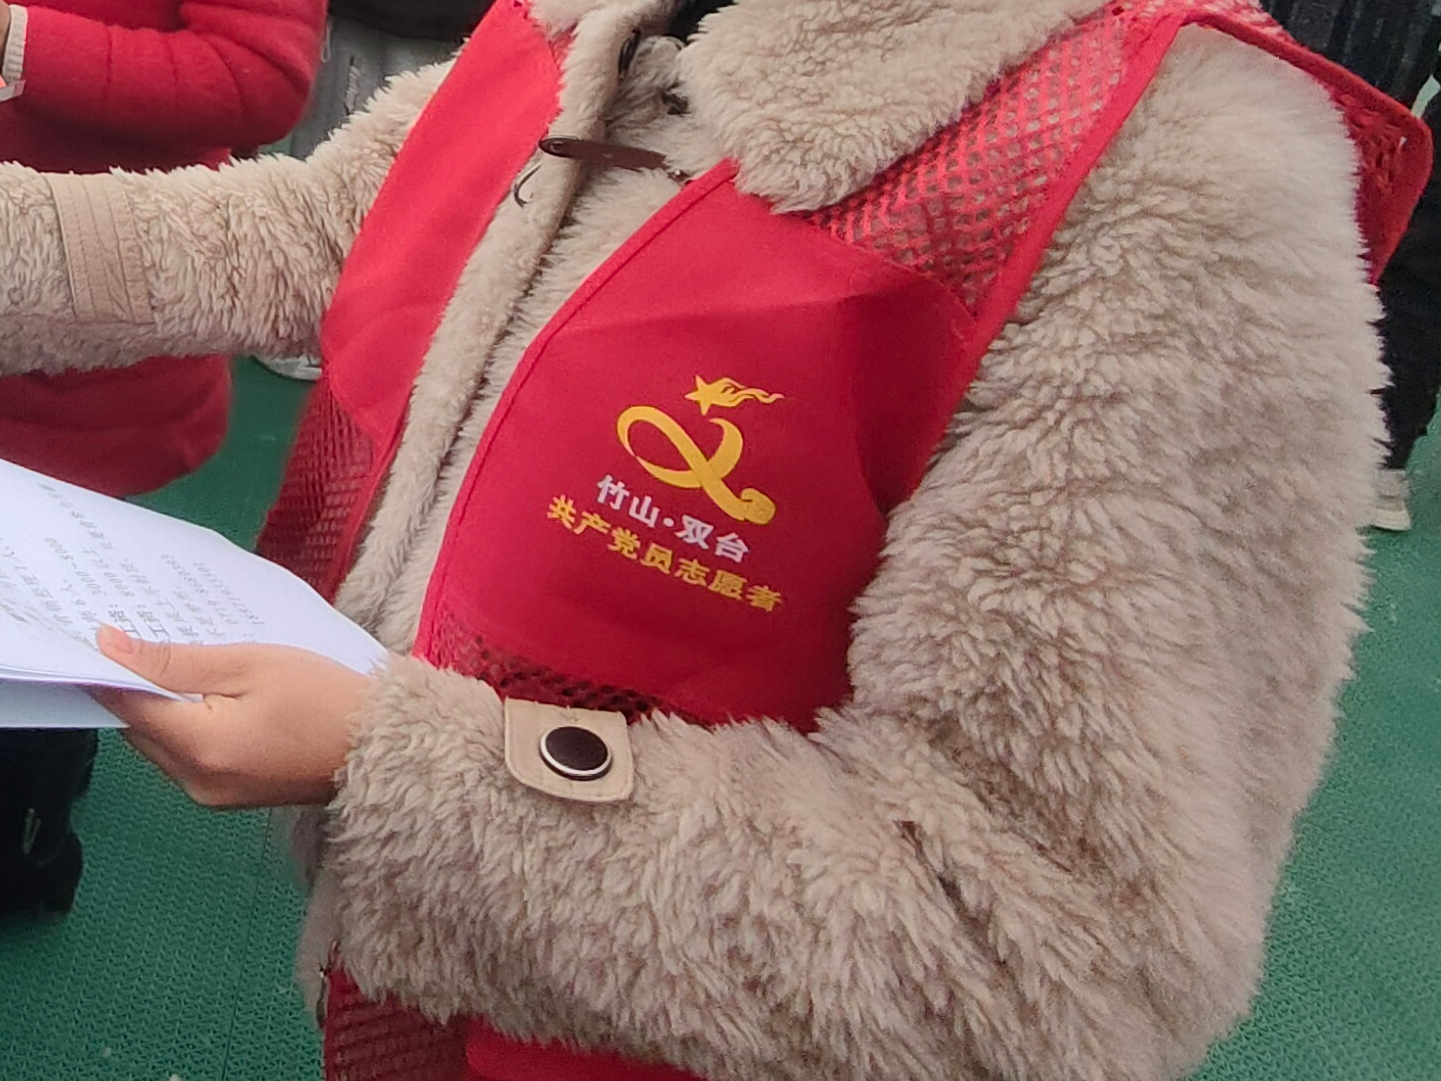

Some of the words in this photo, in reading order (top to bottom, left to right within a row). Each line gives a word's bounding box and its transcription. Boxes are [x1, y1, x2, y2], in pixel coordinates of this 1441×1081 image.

[546, 493, 782, 612] 共产党员志愿者
[597, 474, 749, 563] 竹山·双台
